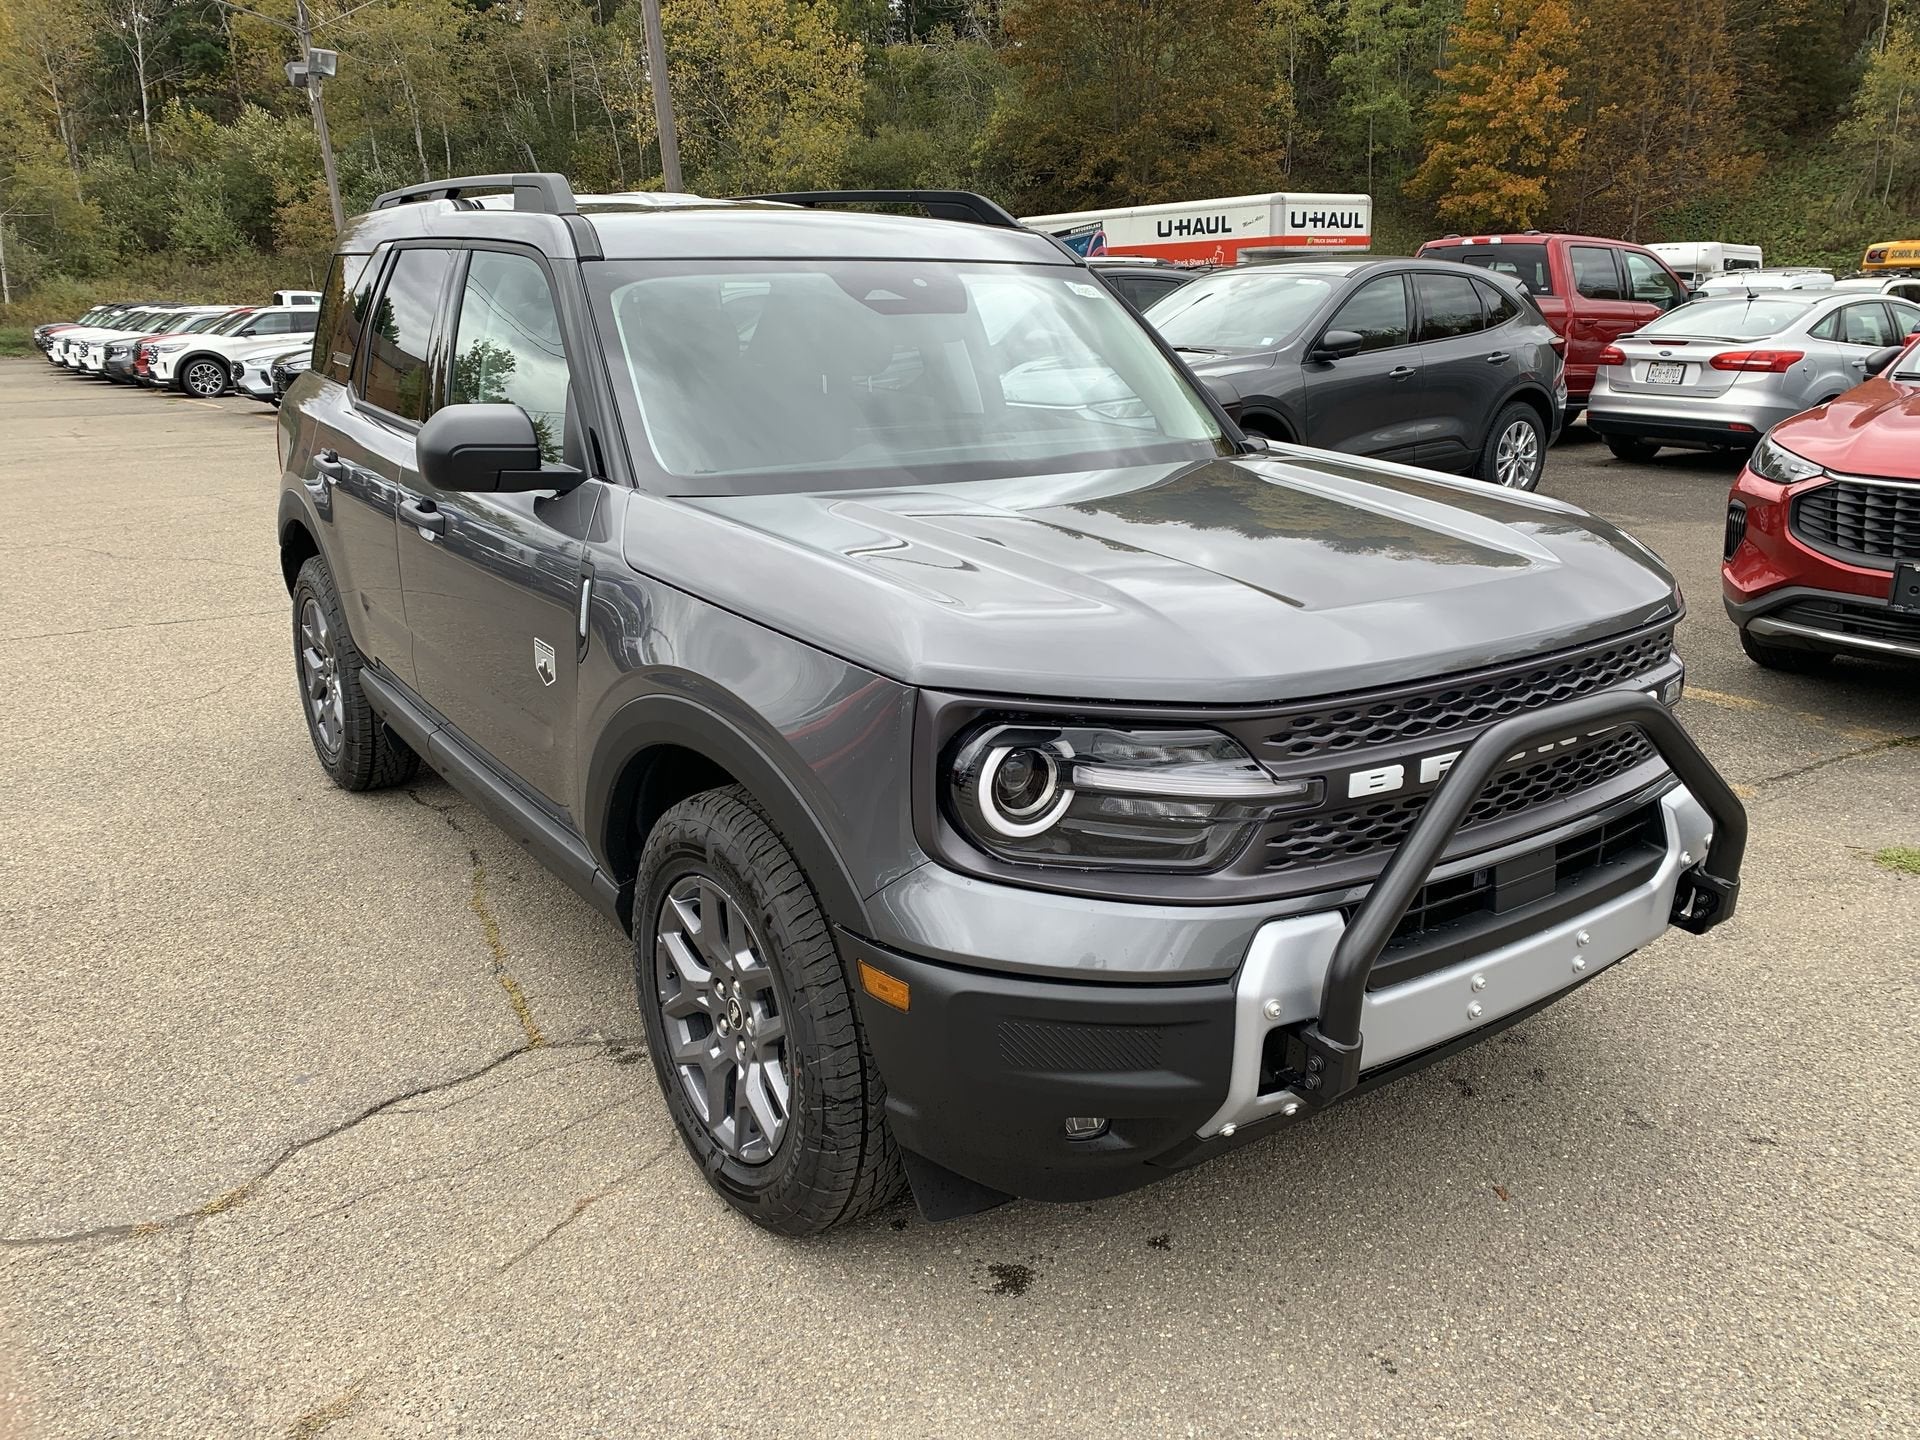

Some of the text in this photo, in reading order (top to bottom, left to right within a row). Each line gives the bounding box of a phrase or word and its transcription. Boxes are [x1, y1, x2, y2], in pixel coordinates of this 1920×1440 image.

[1157, 215, 1232, 238] U-HAUL
[1290, 211, 1364, 229] U-HAUL
[1891, 249, 1912, 258] SCHOOL
